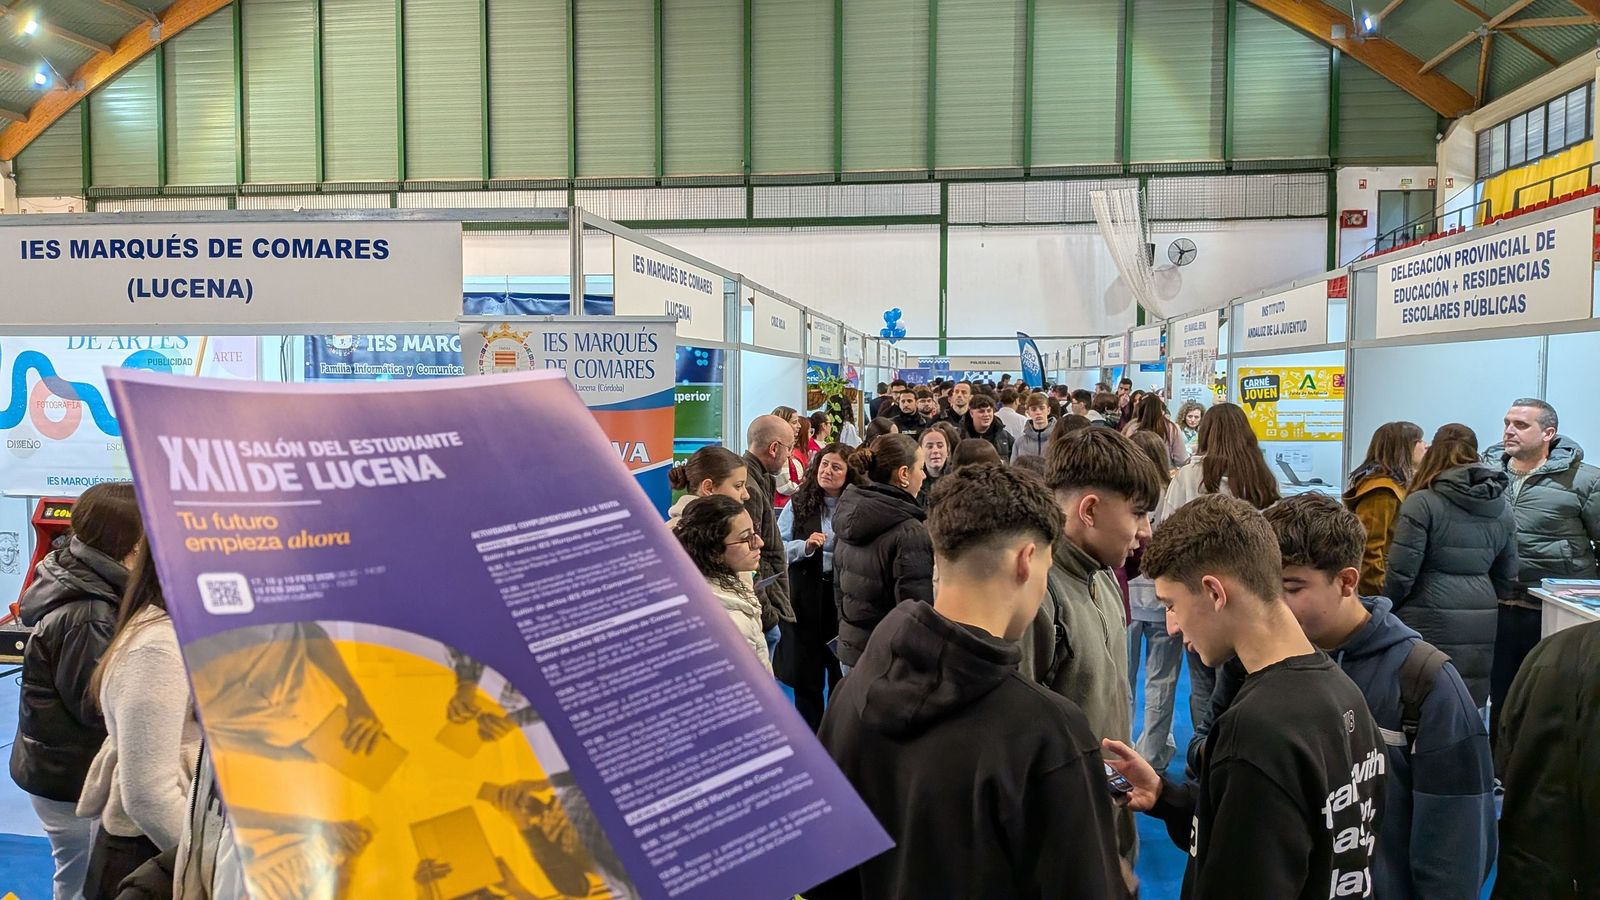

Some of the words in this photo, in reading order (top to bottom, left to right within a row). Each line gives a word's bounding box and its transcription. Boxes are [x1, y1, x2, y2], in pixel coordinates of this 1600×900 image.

[21, 239, 61, 260] IES
[70, 234, 200, 260] MARQUÉS
[209, 239, 243, 259] DE
[252, 239, 390, 260] COMARES
[1391, 252, 1450, 282] DELEGACIÓN
[1455, 237, 1530, 268] PROVINCIAL
[1536, 230, 1556, 252] DE
[632, 253, 645, 275] IES
[646, 259, 679, 284] MARQUÉS
[680, 269, 687, 286] DE
[688, 273, 713, 295] COMARES
[1394, 278, 1449, 304] EDUCACIÓN
[1452, 282, 1459, 293] +
[1463, 259, 1550, 290] RESIDENCIAS
[127, 278, 254, 303] (LUCENA)
[665, 300, 692, 325] (LUCENA)
[1402, 302, 1460, 324] ESCOLARES
[1463, 294, 1527, 318] PÚBLICAS
[542, 332, 568, 352] IES
[573, 326, 658, 355] MARQUÉS
[1267, 325, 1273, 336] DE
[1273, 324, 1279, 335] LA
[1280, 320, 1307, 335] JUVENTUD
[367, 335, 397, 352] IES
[147, 357, 193, 366] PUBLICIDAD
[212, 351, 243, 362] ARTE
[320, 362, 351, 374] Familia
[354, 362, 404, 374] Informática
[407, 366, 414, 376] y
[574, 358, 655, 379] COMARES
[575, 383, 596, 392] Lucena
[597, 383, 625, 392] (Córdoba)
[1243, 376, 1270, 387] CARNÉ
[1245, 388, 1278, 400] JOVEN
[238, 437, 303, 458] SALÓN
[308, 440, 349, 457] DEL
[350, 430, 463, 456] ESTUDIANTE
[157, 435, 248, 492] XXII
[246, 461, 303, 492] DE
[307, 453, 447, 491] LUCENA
[47, 476, 59, 486] IES
[176, 511, 207, 530] Tu
[212, 511, 279, 530] futuro
[185, 533, 283, 555] empieza
[287, 529, 351, 549] ahora
